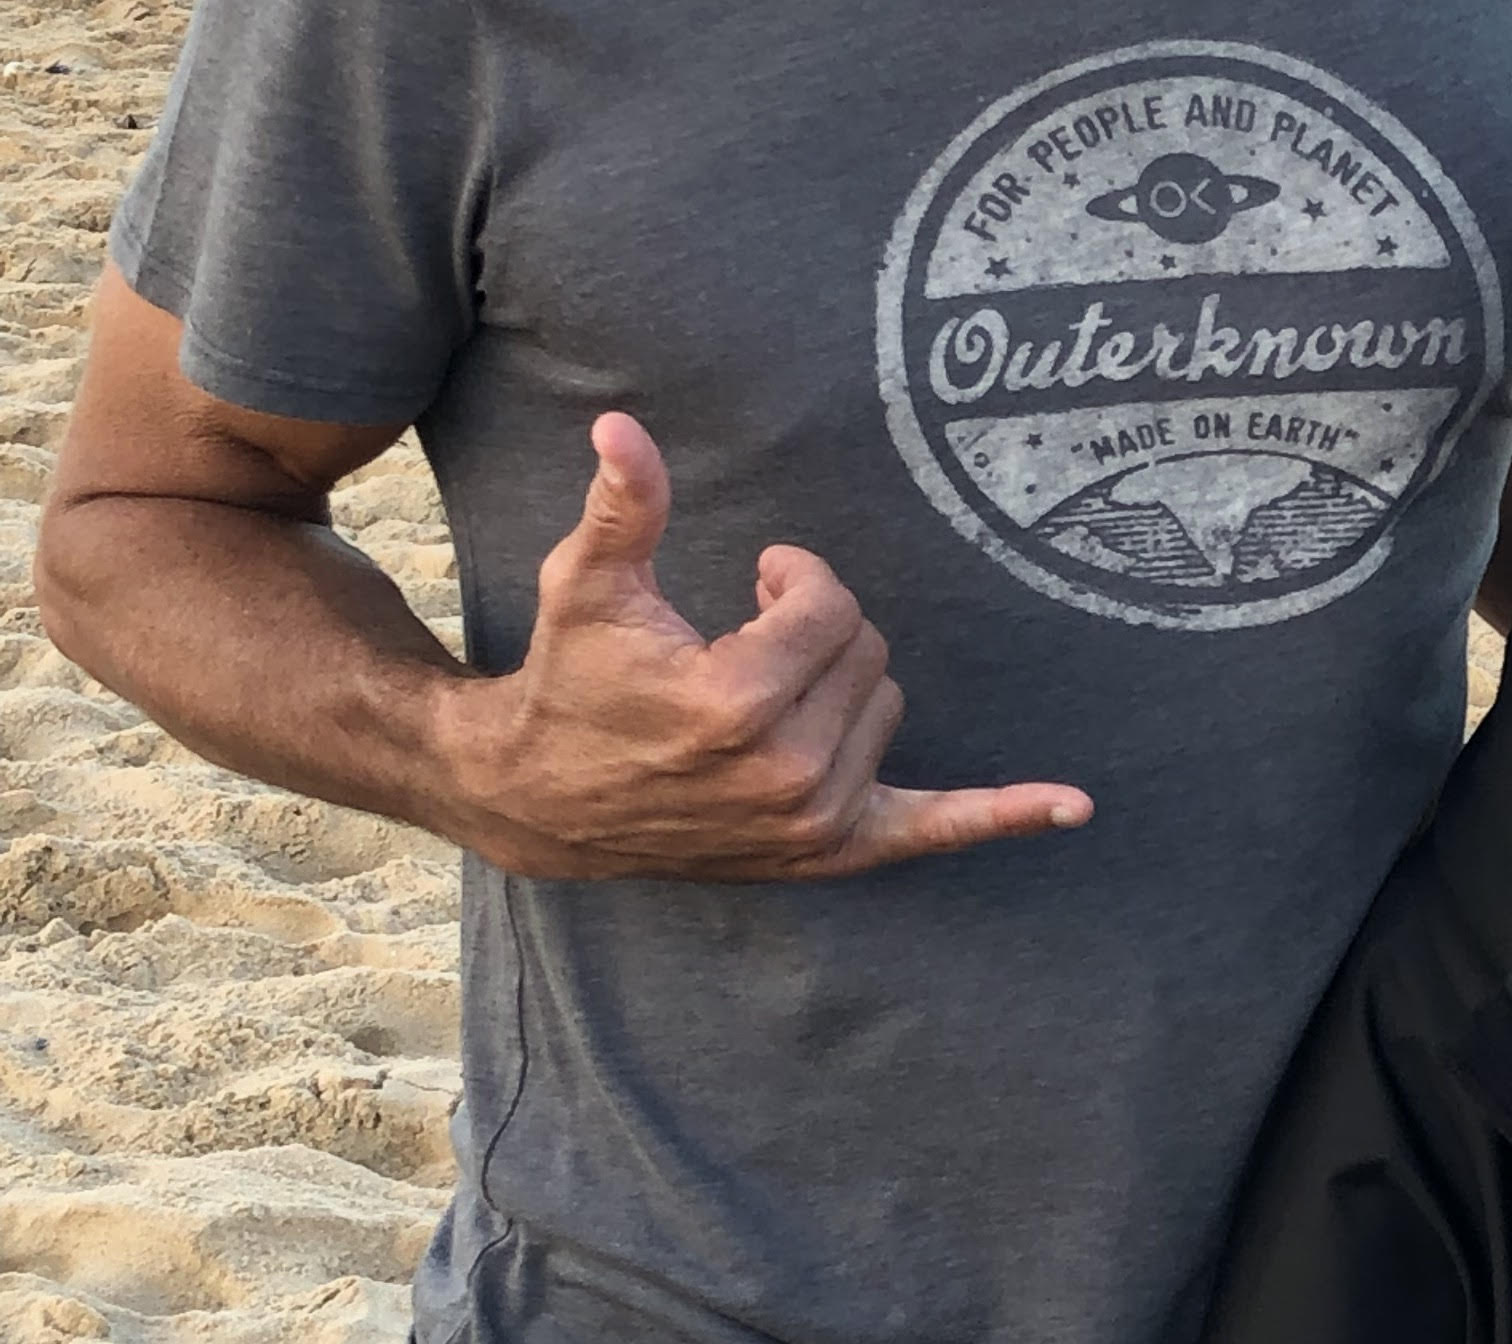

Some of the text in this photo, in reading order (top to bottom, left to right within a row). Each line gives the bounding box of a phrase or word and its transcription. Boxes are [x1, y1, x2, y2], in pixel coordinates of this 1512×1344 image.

[963, 93, 1399, 242] FOR PEOPLE AND PLANET
[929, 293, 1465, 405] Outerknown
[1193, 413, 1231, 439] ON
